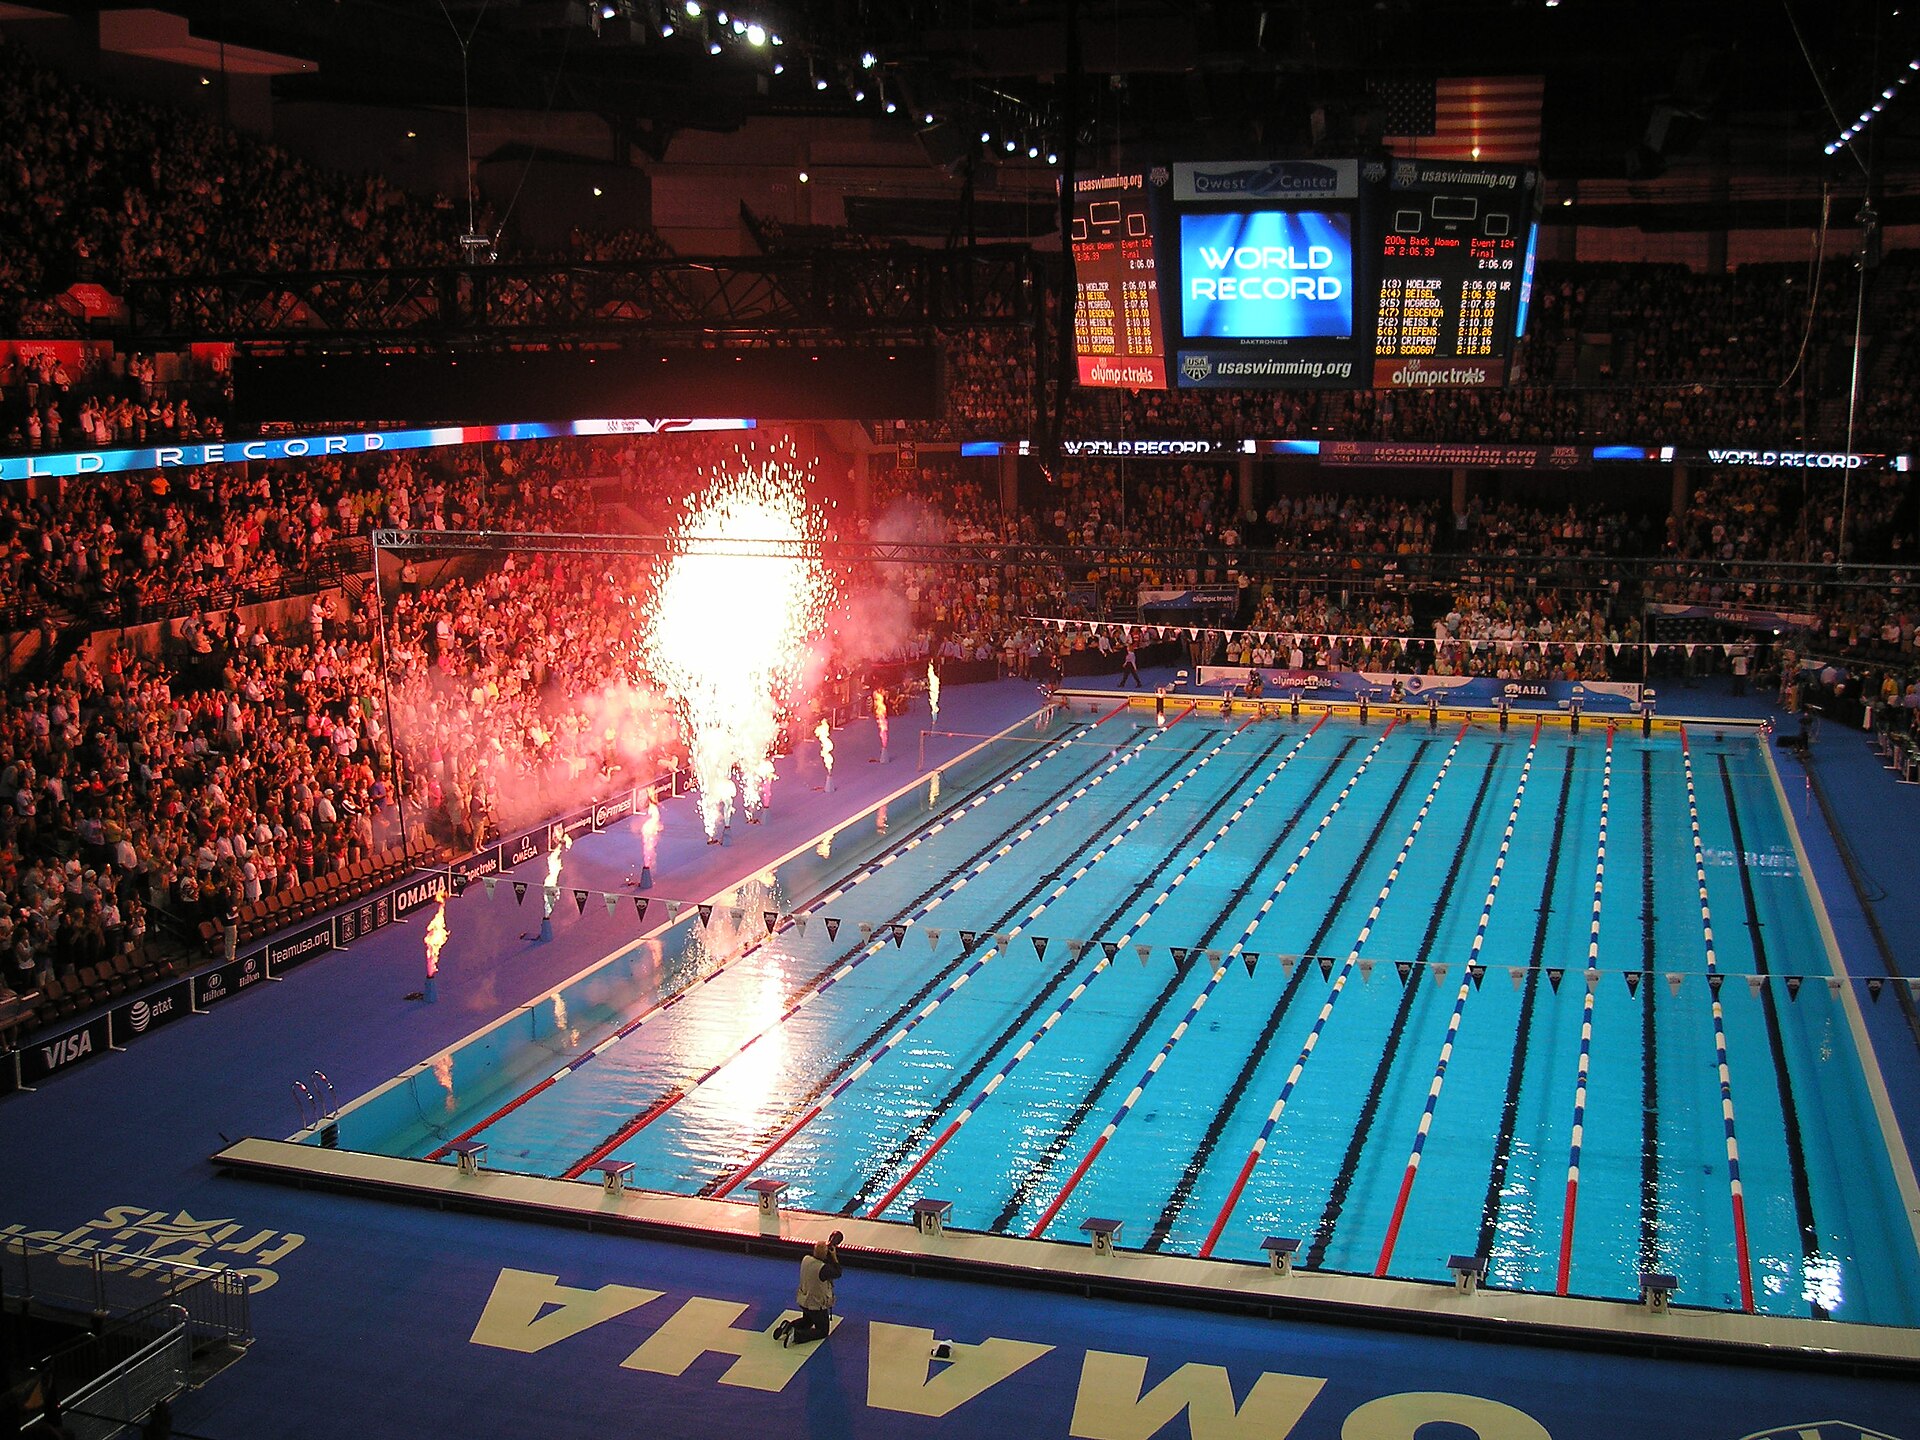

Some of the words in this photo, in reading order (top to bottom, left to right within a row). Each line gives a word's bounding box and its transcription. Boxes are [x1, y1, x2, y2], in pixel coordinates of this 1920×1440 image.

[1078, 173, 1143, 191] usaswimming.org
[1195, 176, 1246, 191] Qwest
[1280, 174, 1336, 189] Center
[1421, 169, 1517, 189] usaswimming.org
[1121, 240, 1139, 249] Event
[1409, 236, 1430, 246] Back
[1471, 239, 1496, 248] Event
[1500, 239, 1514, 248] 124
[1199, 245, 1334, 270] WORLD
[1470, 249, 1494, 258] Final
[1129, 258, 1155, 270] 2:06.09
[1478, 259, 1513, 270] 2:06.09
[1191, 276, 1342, 301] RECORD
[1406, 279, 1442, 290] HOELZER
[1462, 280, 1497, 291] 2:06.09
[1500, 281, 1511, 291] WR
[1405, 289, 1436, 299] BEISEL
[1461, 290, 1497, 300] 2:06.92
[1460, 299, 1496, 309] 2:07.69
[1403, 307, 1444, 318] DESCENZA
[1459, 308, 1495, 318] 2:10.00
[1402, 317, 1428, 327] HEISS
[1459, 318, 1494, 327] 2:10.18
[1458, 327, 1493, 337] 2:10.26
[1401, 336, 1437, 346] CRIPPEN
[1457, 336, 1492, 346] 2:12.16
[1400, 345, 1436, 355] SCROGGY
[1456, 345, 1491, 355] 2:12.89
[1188, 357, 1205, 366] USA
[1217, 358, 1352, 378] usaswimming.org
[1091, 364, 1128, 384] olympic
[1392, 366, 1449, 387] olympic
[1064, 441, 1132, 455] WORLD
[1134, 441, 1210, 455] RECORD
[0, 453, 104, 480] LD
[155, 433, 385, 468] RECORD
[1374, 444, 1538, 469] usaswimming.org
[1708, 449, 1777, 465] WORLD
[1779, 452, 1861, 469] RECORD
[1272, 675, 1308, 688] olympic
[606, 799, 632, 818] FITNESS
[513, 845, 538, 864] OMEGA
[397, 875, 446, 911] OMAHA
[272, 930, 330, 964] teamusa.org
[239, 971, 260, 987] Hilton
[202, 987, 227, 1003] Hilton
[152, 996, 174, 1017] at&t
[41, 1029, 92, 1069] VISA
[460, 1153, 466, 1169] 1
[607, 1176, 614, 1189] 2
[762, 1195, 769, 1210] 3
[926, 1214, 933, 1230] 4
[1097, 1235, 1104, 1250] 5
[1276, 1255, 1284, 1269] 6
[1462, 1274, 1470, 1289] 7
[1653, 1291, 1662, 1307] 8
